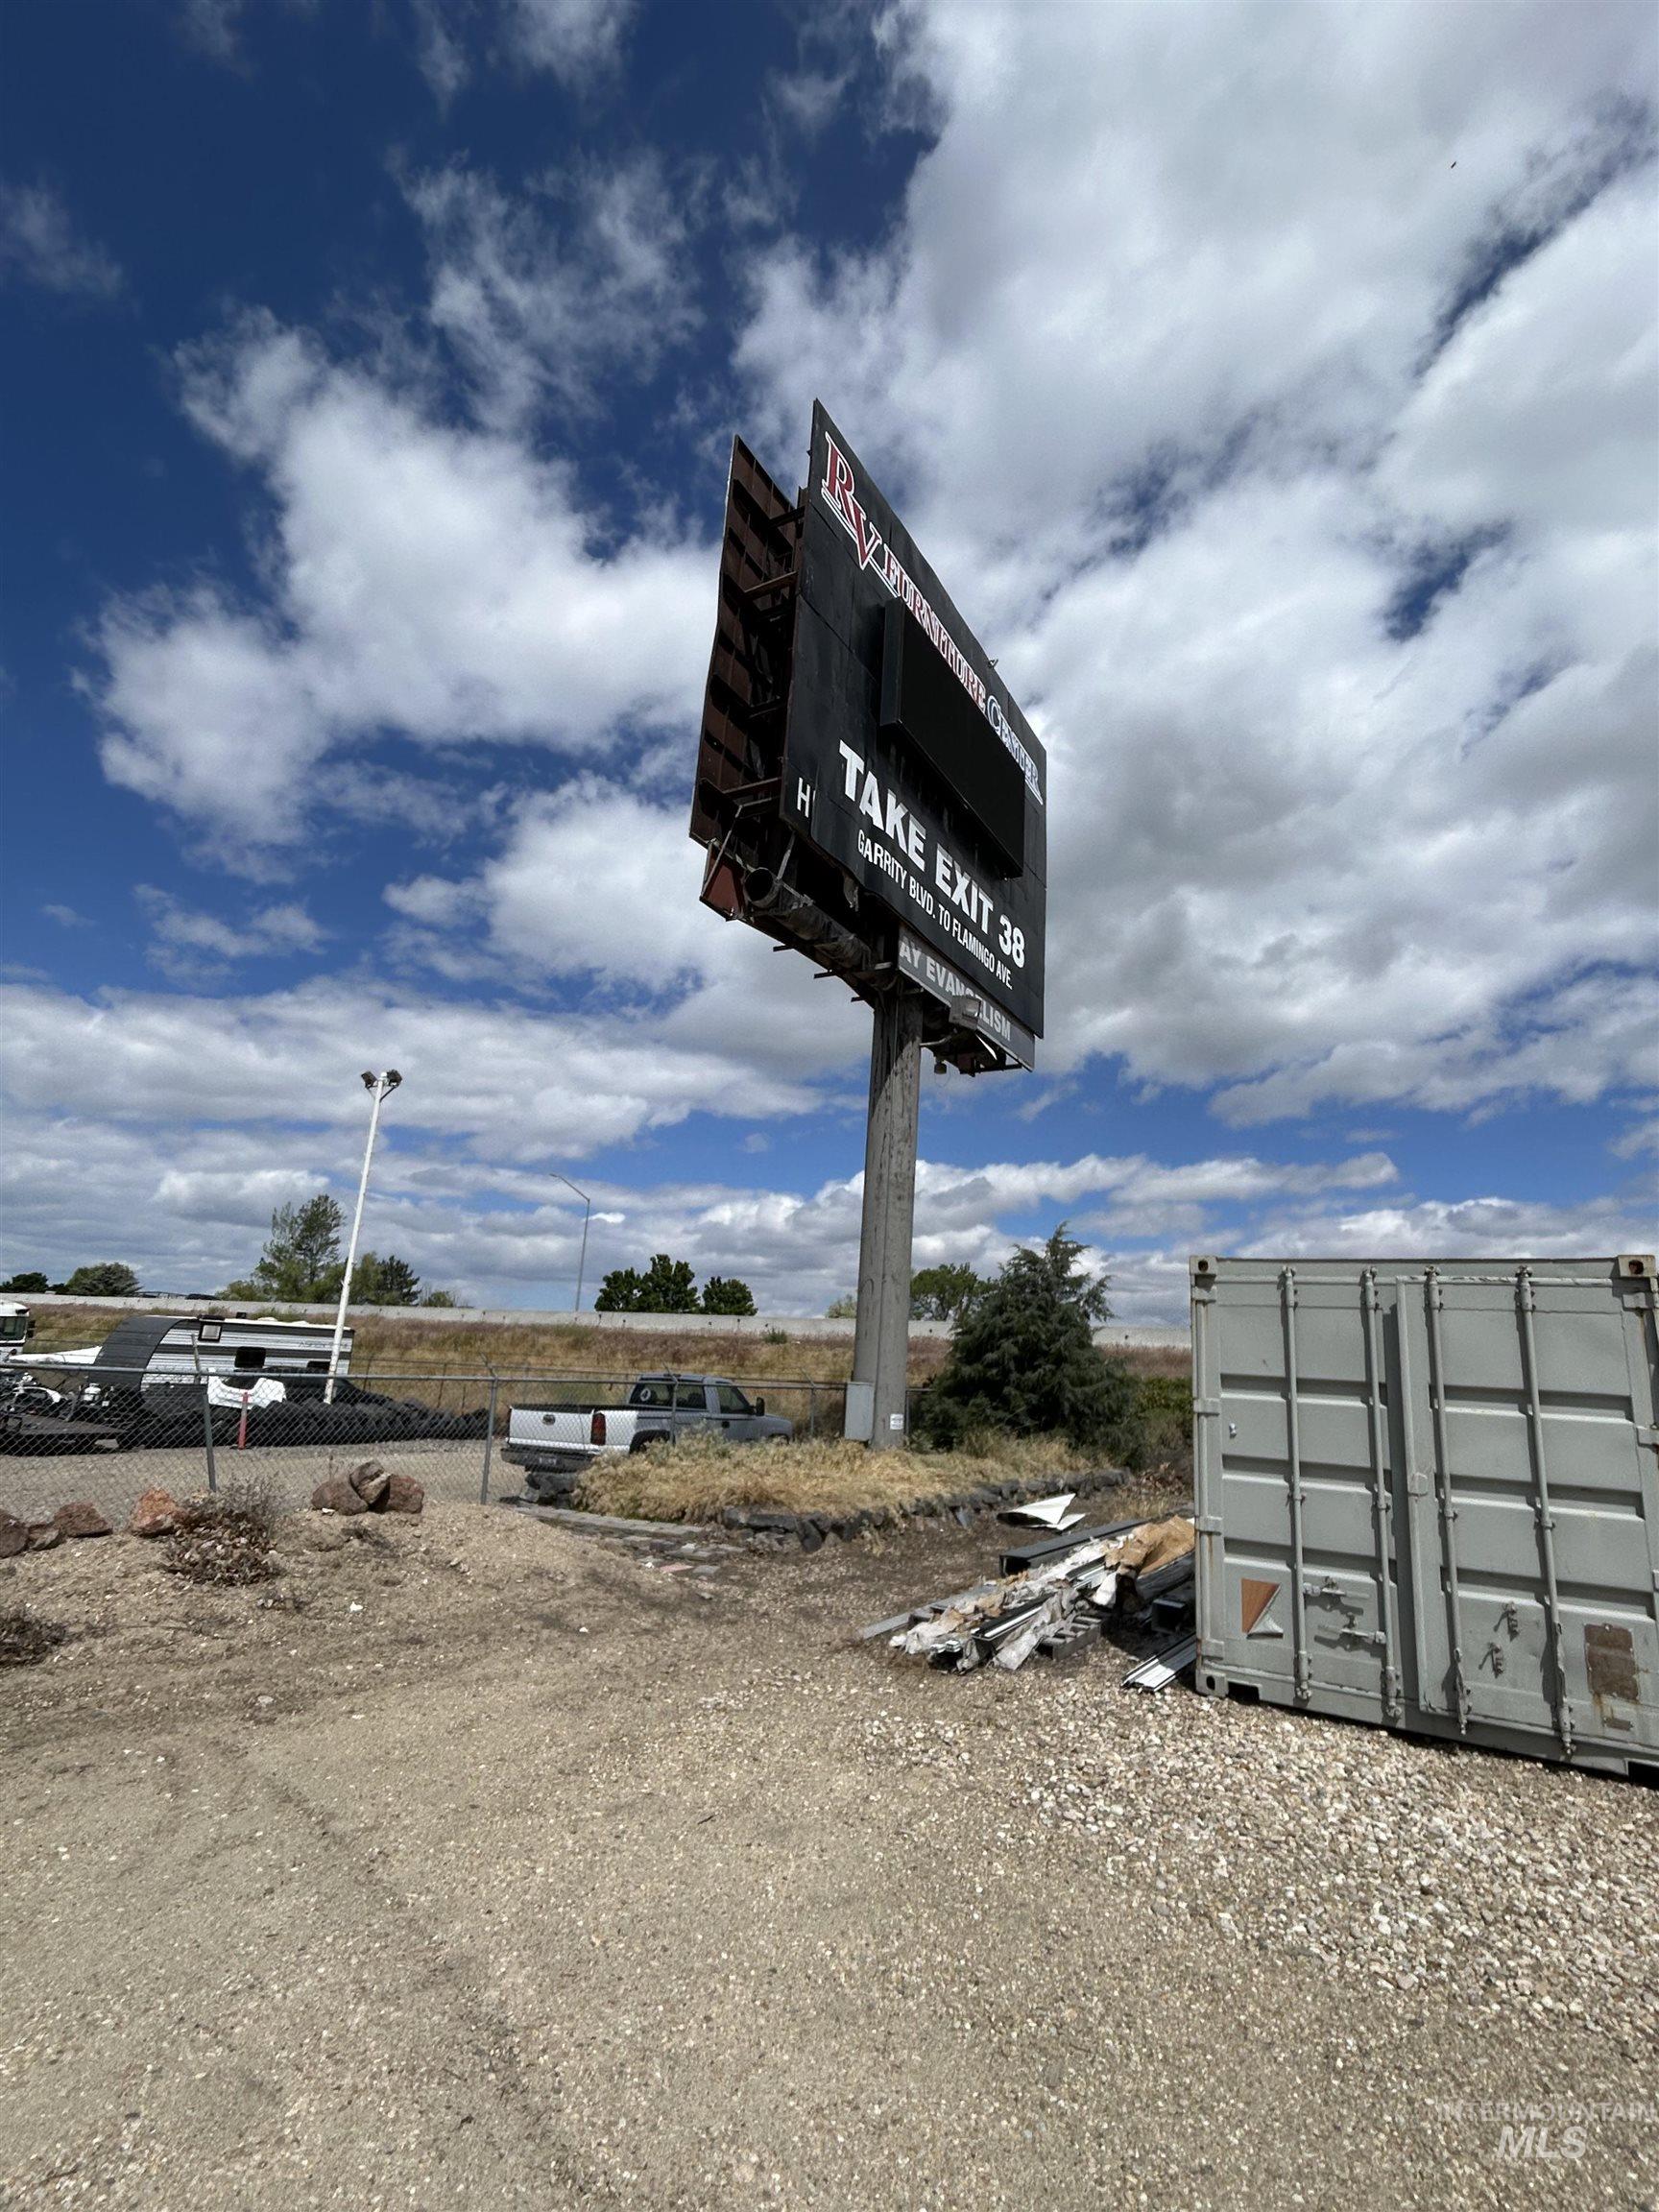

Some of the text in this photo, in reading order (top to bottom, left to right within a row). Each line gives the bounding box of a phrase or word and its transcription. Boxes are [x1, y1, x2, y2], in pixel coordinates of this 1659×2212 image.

[822, 431, 882, 570] RV
[883, 543, 986, 714] FURNITURE
[839, 739, 1025, 969] TAKE EXIT 38
[857, 829, 1013, 990] GARRITY BLVD. TO FLAMINGO AVE.
[926, 956, 1011, 1041] EVANLISM
